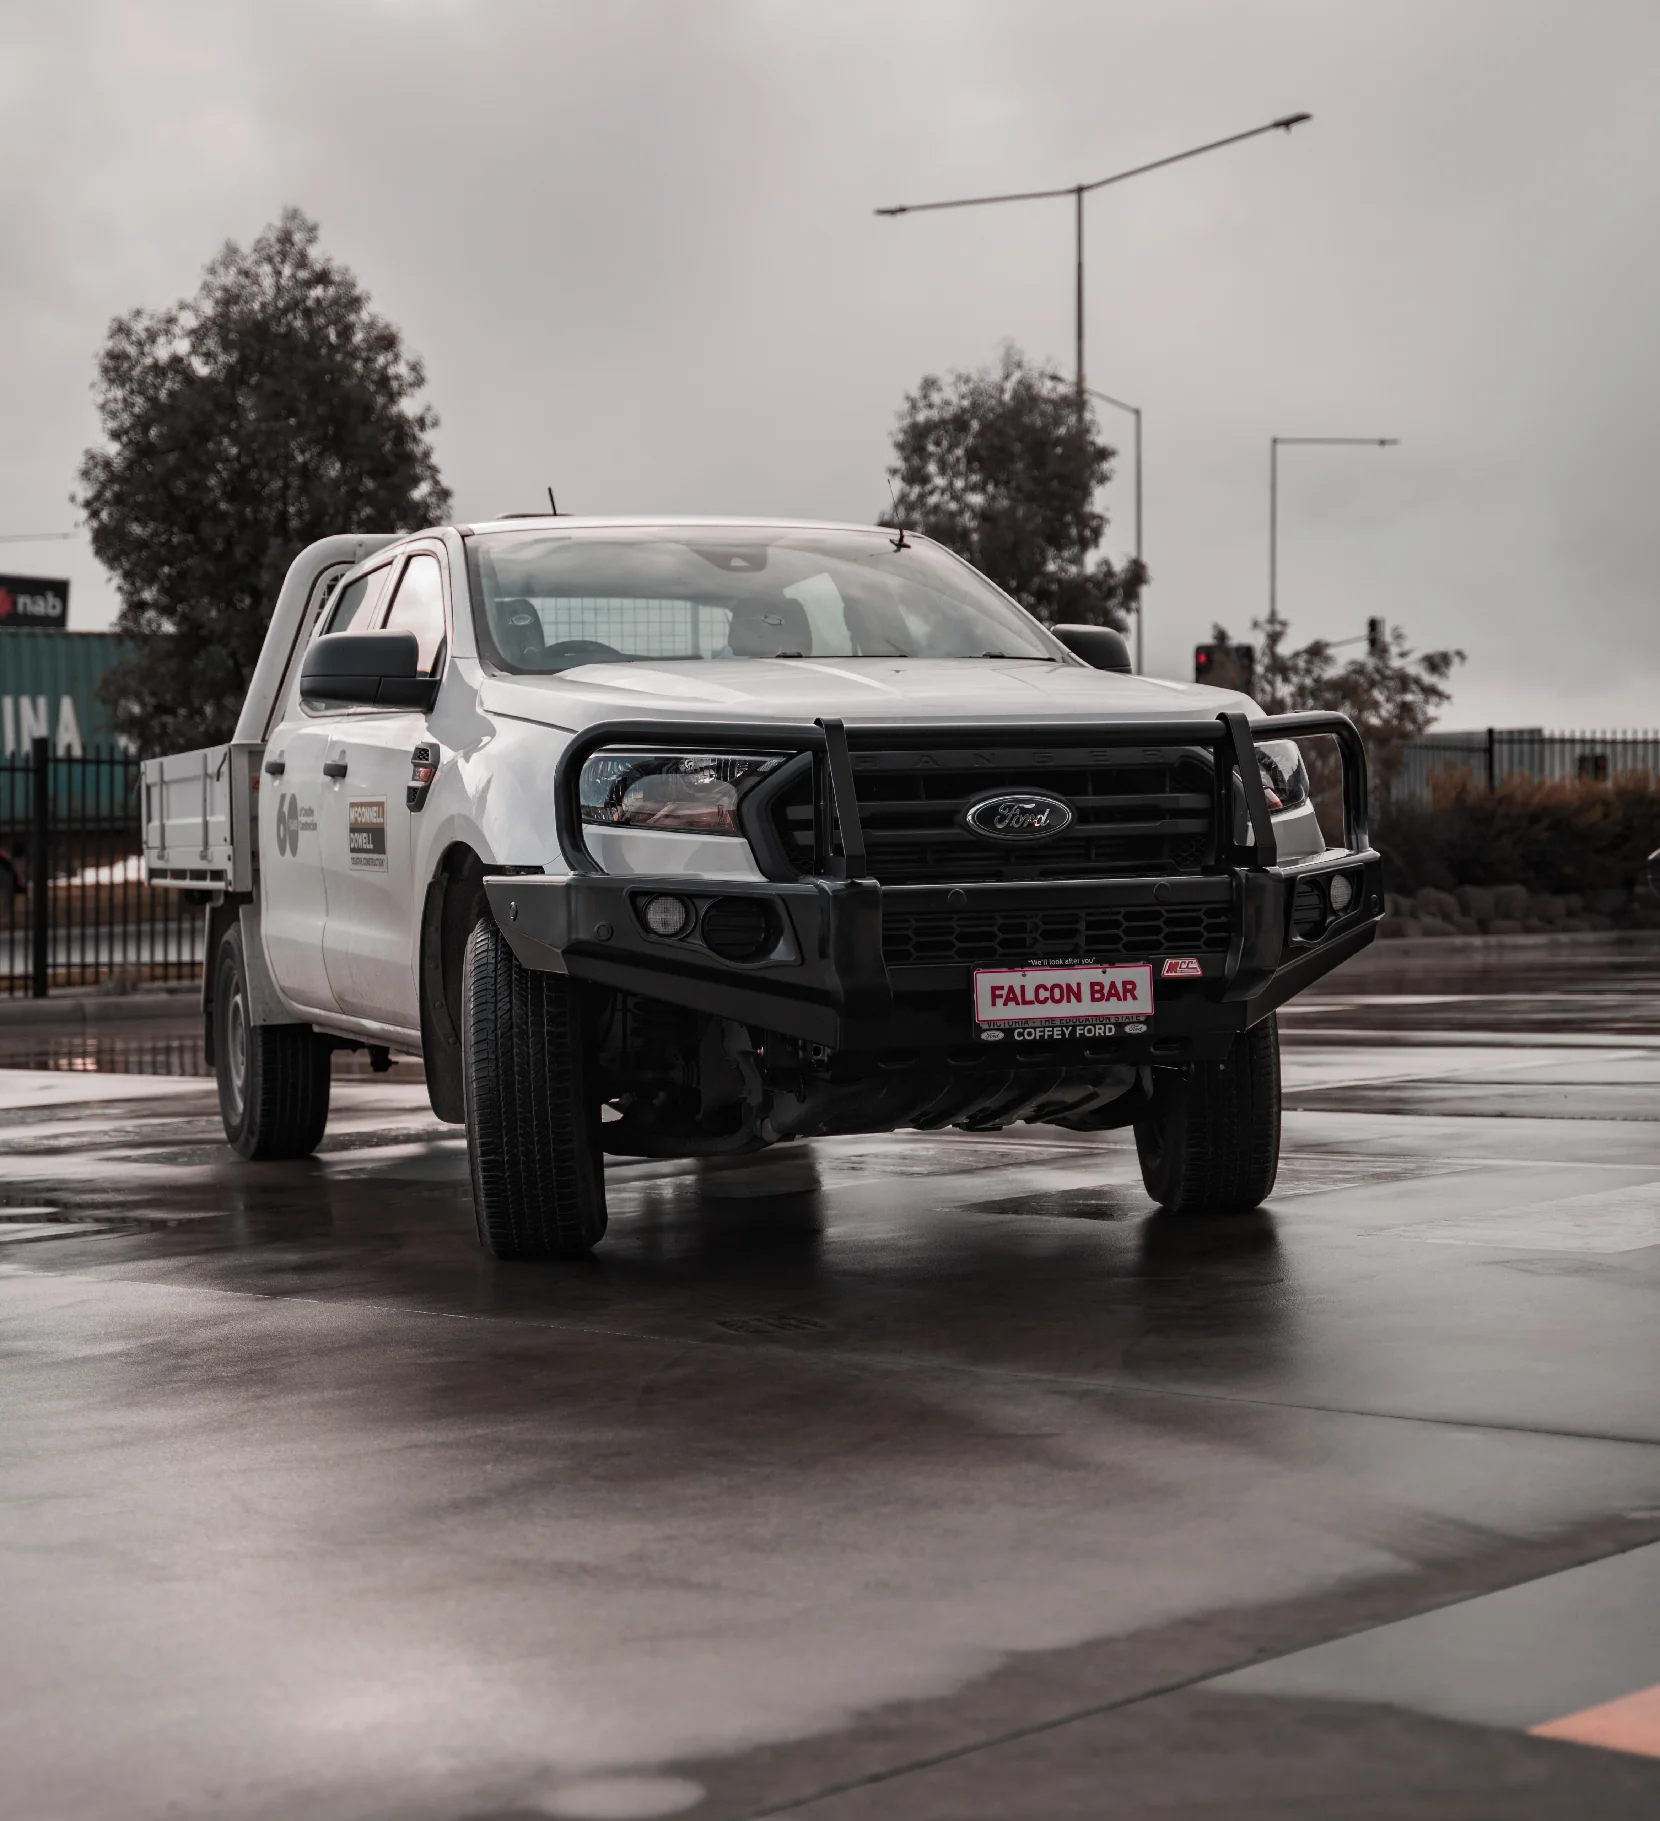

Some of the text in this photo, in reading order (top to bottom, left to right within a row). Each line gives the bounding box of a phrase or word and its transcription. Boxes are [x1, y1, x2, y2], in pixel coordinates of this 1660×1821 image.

[16, 590, 63, 617] nab
[854, 749, 1164, 770] RANGER
[993, 802, 1050, 829] Ford
[350, 832, 374, 849] DOWELL
[1064, 957, 1080, 965] after
[1166, 960, 1198, 974] MCC
[990, 980, 1139, 1007] FALCON BAR
[1013, 1024, 1116, 1040] COFFEY FORD
